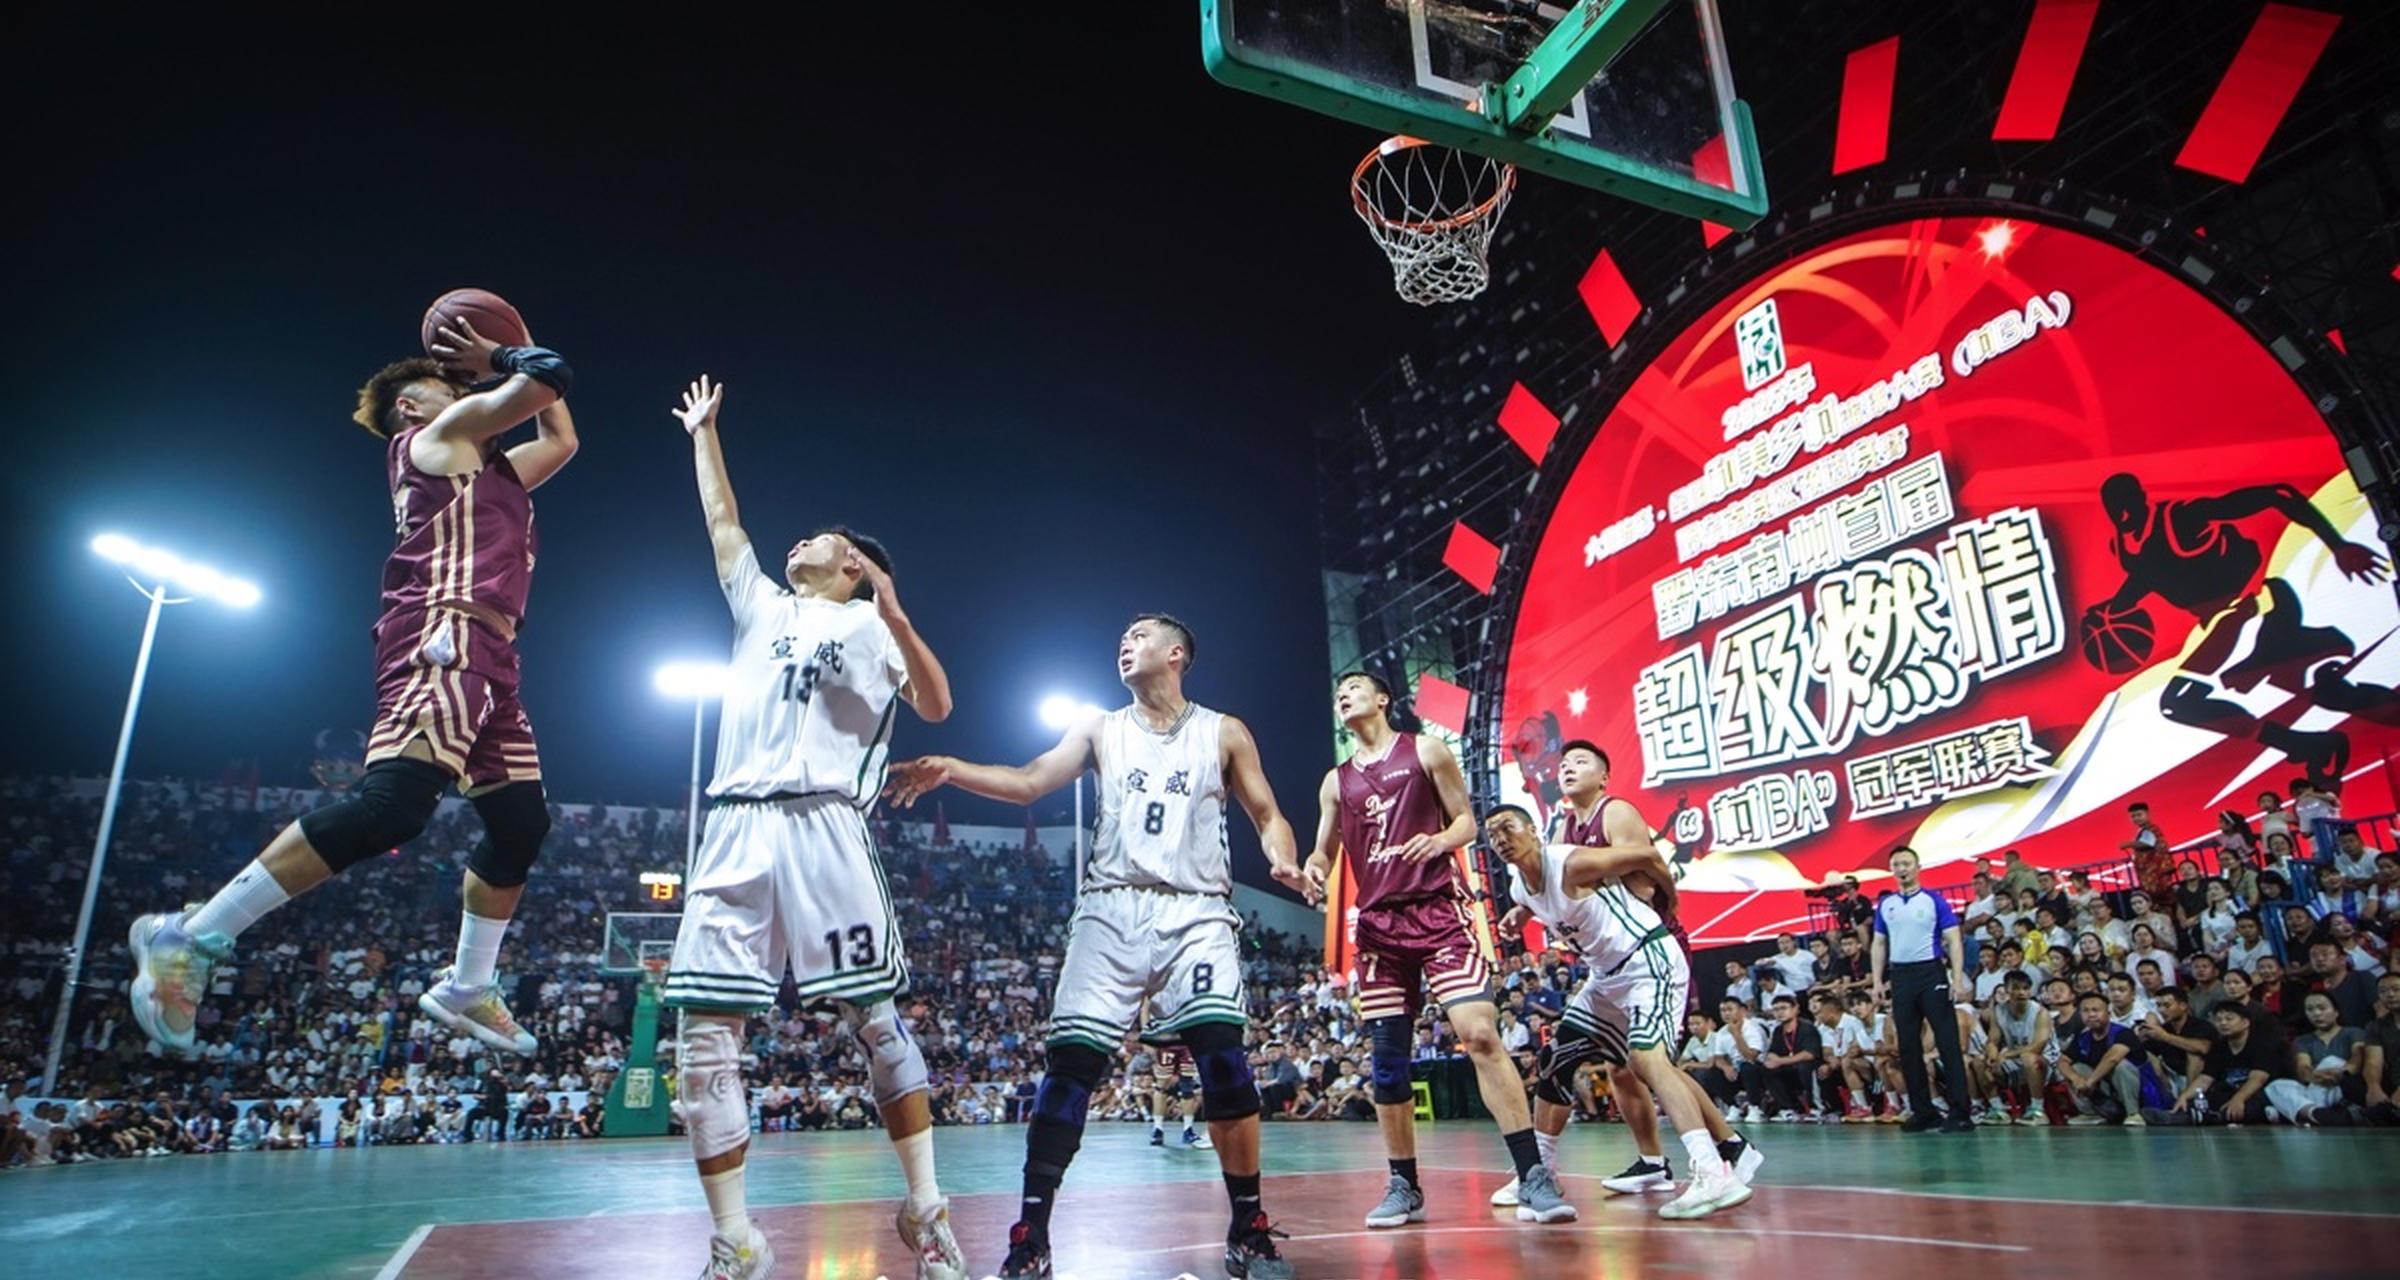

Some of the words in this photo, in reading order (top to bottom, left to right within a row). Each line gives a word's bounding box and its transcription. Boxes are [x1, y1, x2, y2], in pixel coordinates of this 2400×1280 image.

[1652, 451, 1954, 640] 黔东南州首届
[769, 636, 844, 674] 宣威
[1634, 508, 2065, 787] 超级燃情
[781, 664, 820, 705] 13
[1126, 768, 1191, 796] 宣威
[1846, 717, 2036, 820] 冠军联赛
[1144, 802, 1165, 836] 8
[651, 880, 674, 900] 13
[824, 924, 876, 970] 13
[1192, 963, 1213, 994] 8
[1361, 953, 1379, 982] 7
